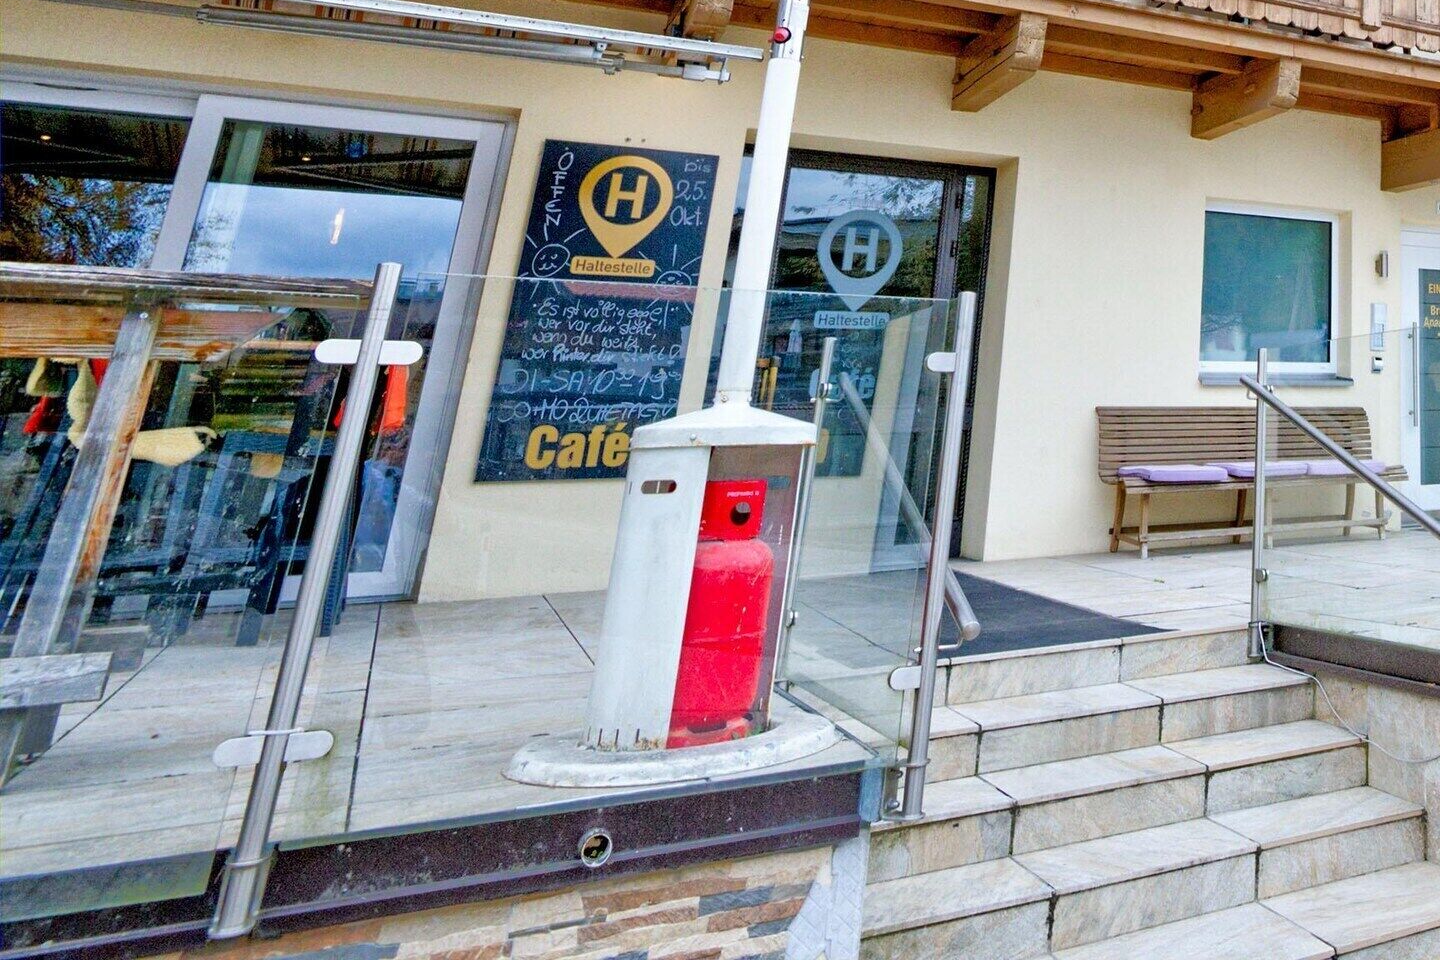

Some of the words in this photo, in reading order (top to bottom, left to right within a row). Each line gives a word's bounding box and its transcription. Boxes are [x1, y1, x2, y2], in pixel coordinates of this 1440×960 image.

[605, 173, 648, 219] H
[575, 258, 652, 275] Haltestelle
[841, 227, 880, 272] H
[817, 313, 887, 328] Haltestelle
[525, 423, 630, 469] Café
